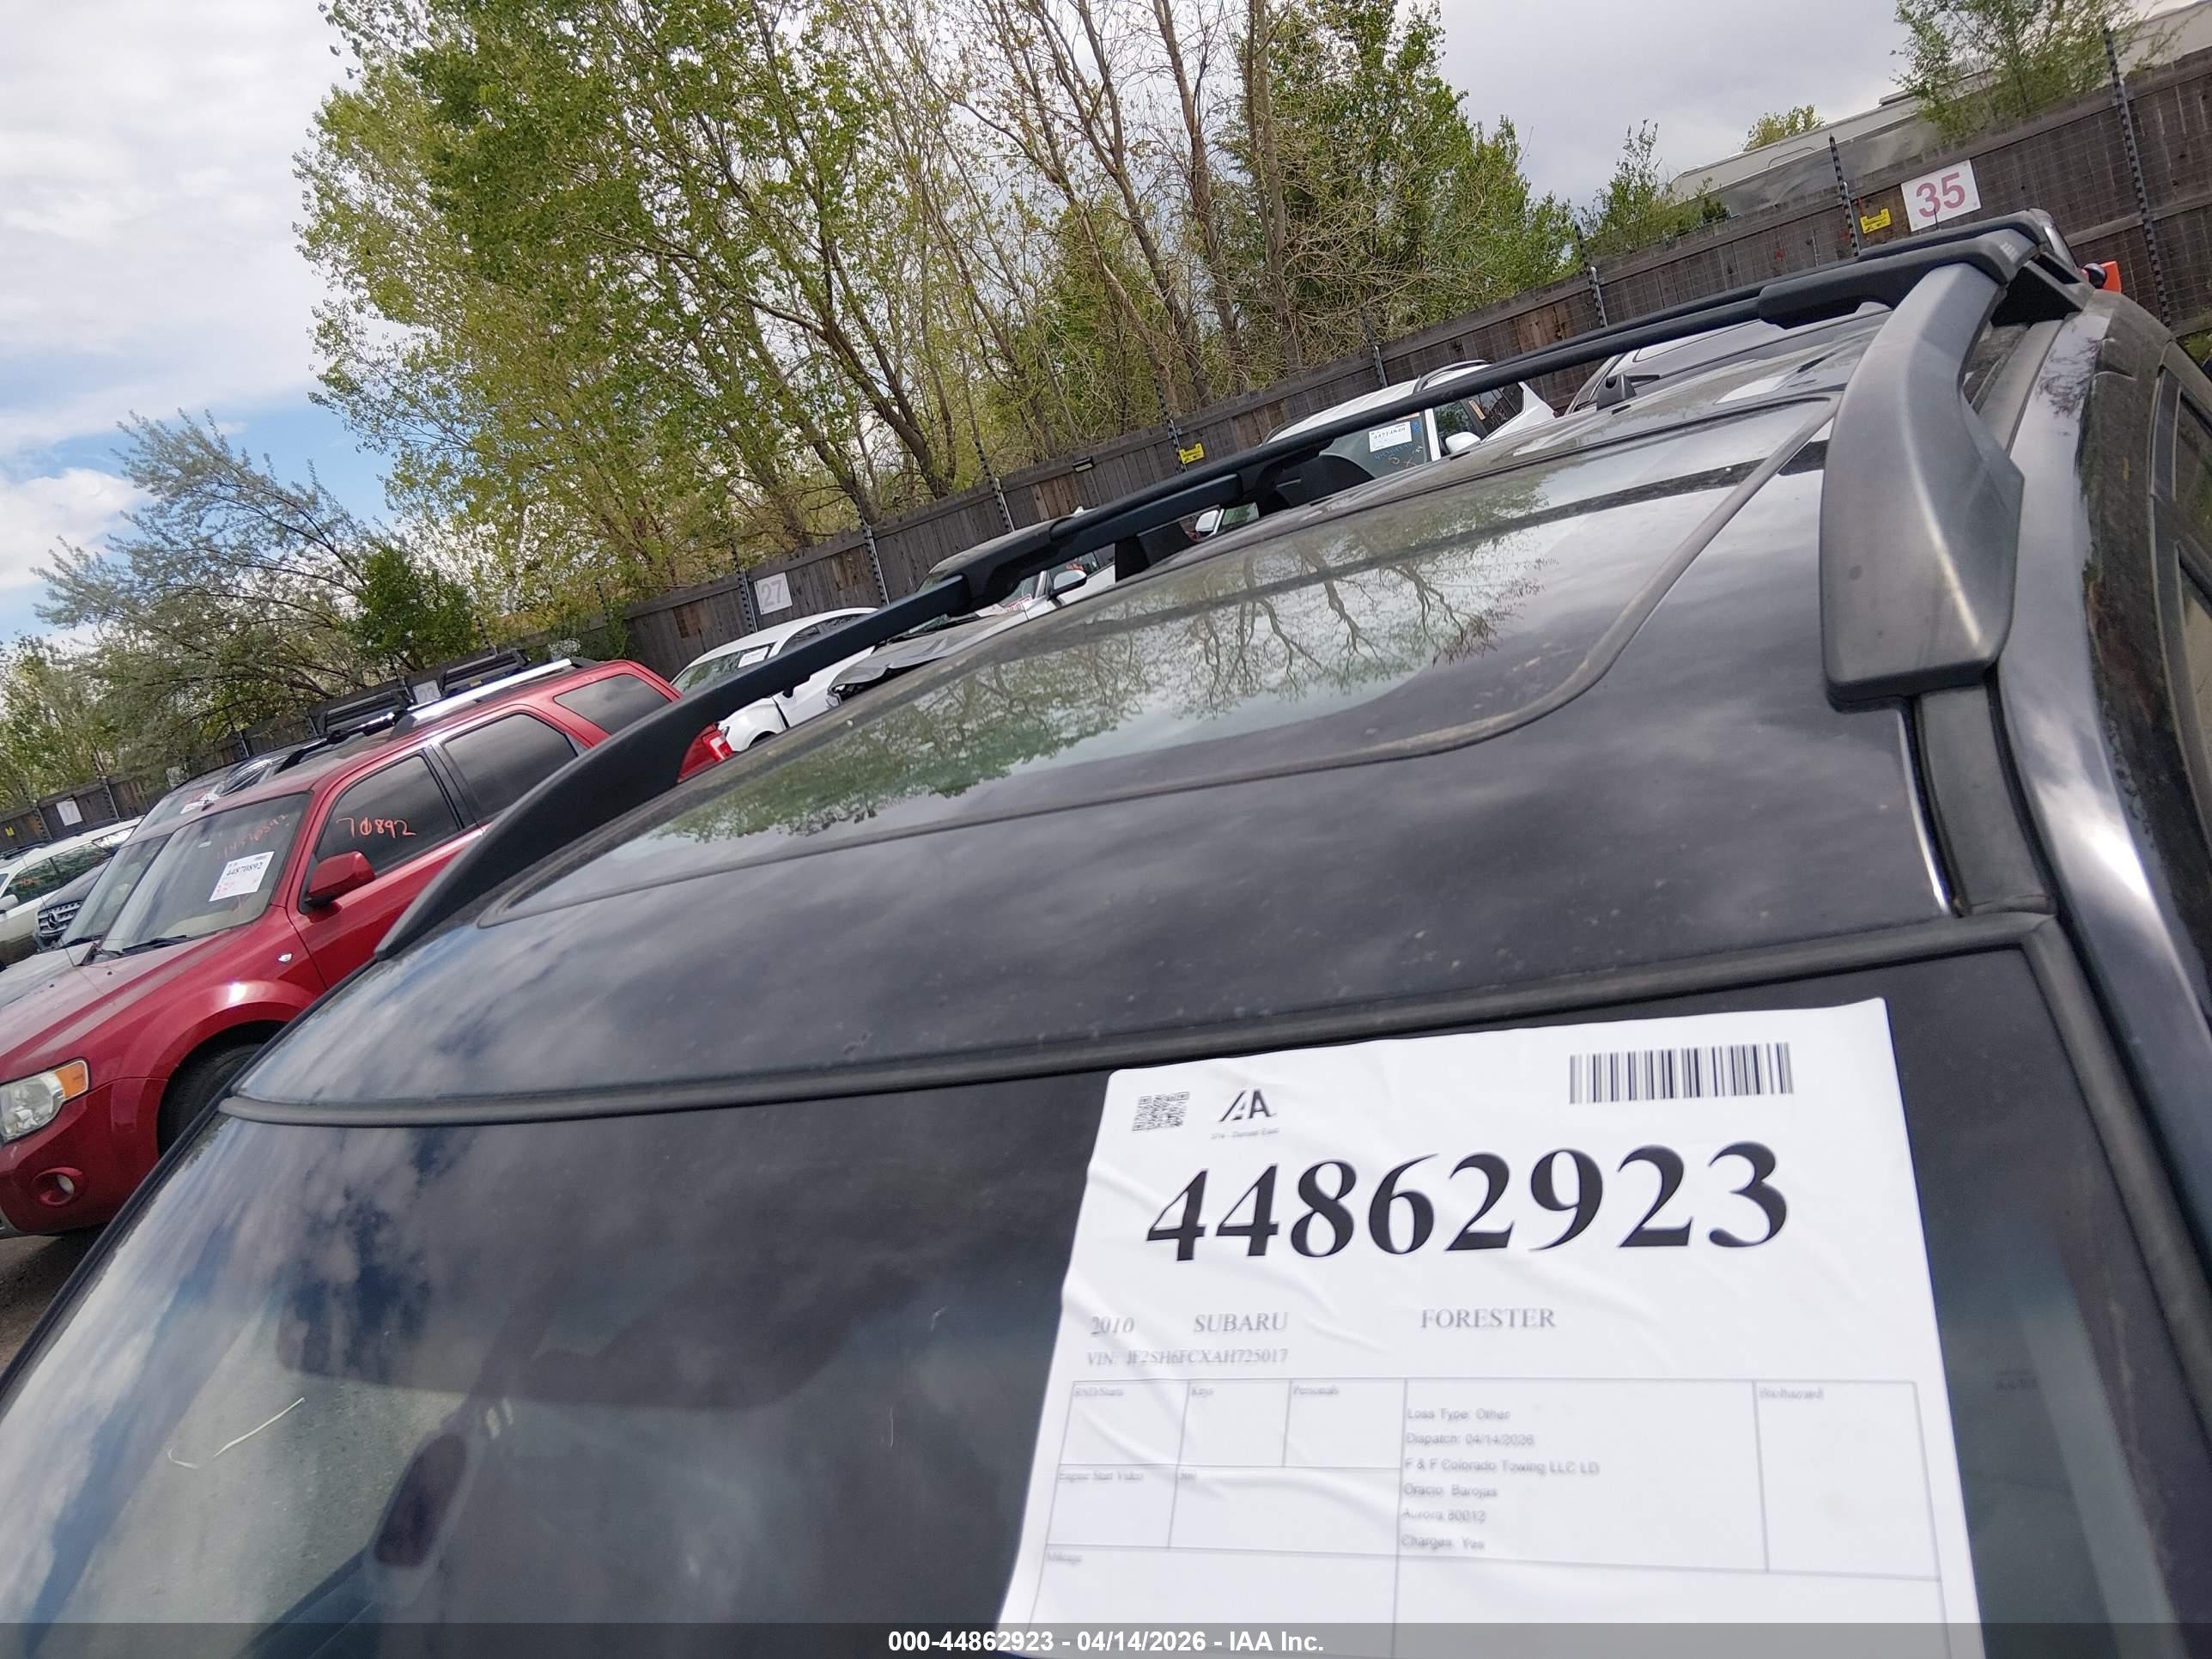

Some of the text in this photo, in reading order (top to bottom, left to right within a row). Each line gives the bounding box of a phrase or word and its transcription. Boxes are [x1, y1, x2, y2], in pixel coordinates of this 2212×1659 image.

[1917, 172, 1966, 217] 35
[762, 579, 782, 607] 27
[1146, 1140, 1788, 1261] 44862923
[1090, 1307, 1557, 1335] 2010 SUBARU FORESTER
[1407, 1407, 1435, 1419] Loss
[1476, 1407, 1511, 1420] Other
[1405, 1458, 1414, 1469] F
[1417, 1458, 1425, 1470] &
[1429, 1458, 1438, 1469] F
[1442, 1457, 1497, 1471] Colorado
[1502, 1459, 1547, 1475] Towing
[1549, 1460, 1575, 1474] LLC
[1401, 1507, 1443, 1520] Aurora
